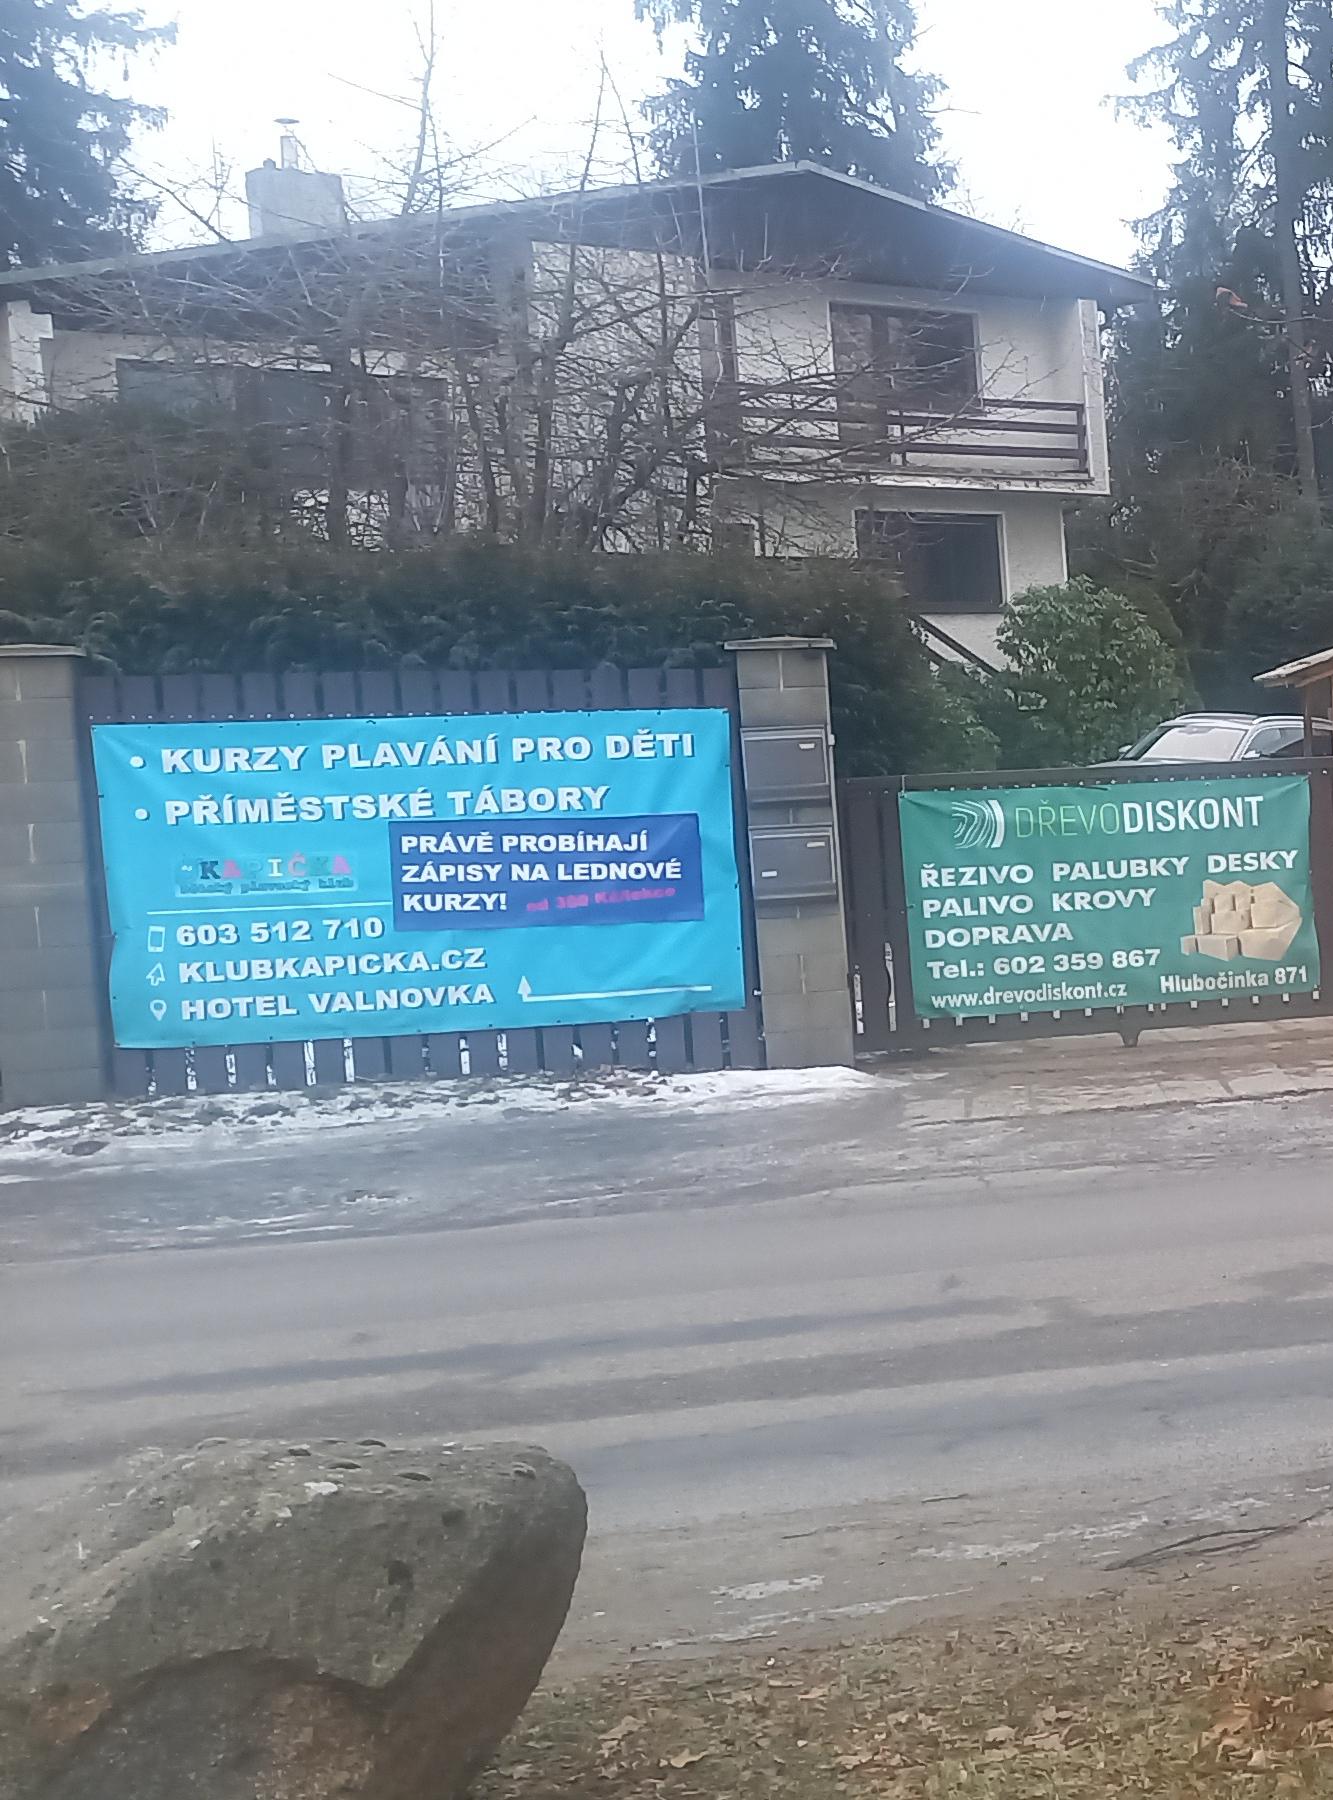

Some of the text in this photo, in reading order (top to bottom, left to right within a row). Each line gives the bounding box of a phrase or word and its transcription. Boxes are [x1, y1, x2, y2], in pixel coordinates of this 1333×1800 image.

[161, 729, 695, 774] KURZY PLAVÁNÍ PRO DĚTI
[165, 784, 610, 826] PŘÍMĚSTSKÉ TÁBORY
[1014, 795, 1265, 839] DŘEVODISKONT
[401, 829, 649, 855] PRÁVĚ PROBÍHAJÍ
[401, 857, 683, 883] ZÁPISY NA LEDNOVÉ
[919, 849, 1299, 889] ŘEZIVO PALUBKY DESKY
[402, 892, 508, 914] KURZY!
[922, 887, 1157, 919] PALIVO KROVY
[176, 916, 386, 947] 603 512 710
[924, 922, 1075, 949] DOPRAVA
[178, 947, 488, 984] KLUBKAPICKA.CZ
[926, 948, 1161, 980] Tel.: 602 359 867
[181, 983, 496, 1021] HOTEL VALNOVKA
[931, 965, 1308, 1009] www.drevodiskont.cz Hlubočinka 871
